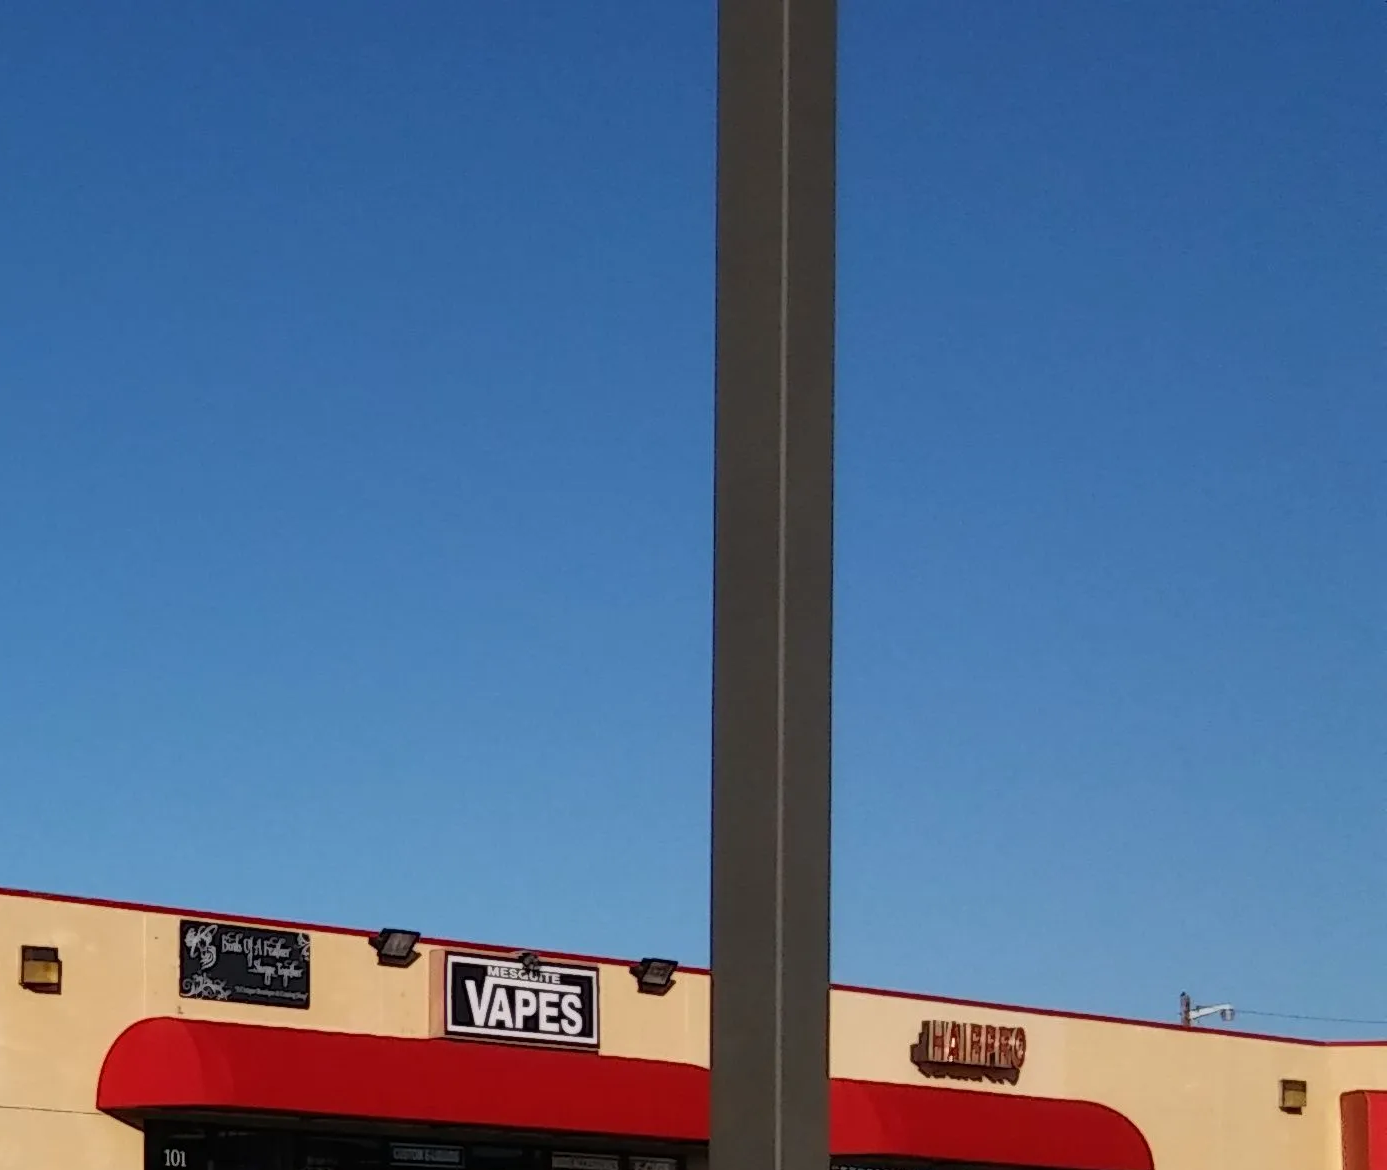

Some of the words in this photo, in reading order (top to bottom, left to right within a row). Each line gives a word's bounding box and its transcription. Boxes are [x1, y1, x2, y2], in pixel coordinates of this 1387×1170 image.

[487, 966, 561, 984] MESQUITE
[465, 976, 583, 1035] VAPES
[163, 1149, 188, 1168] 101
